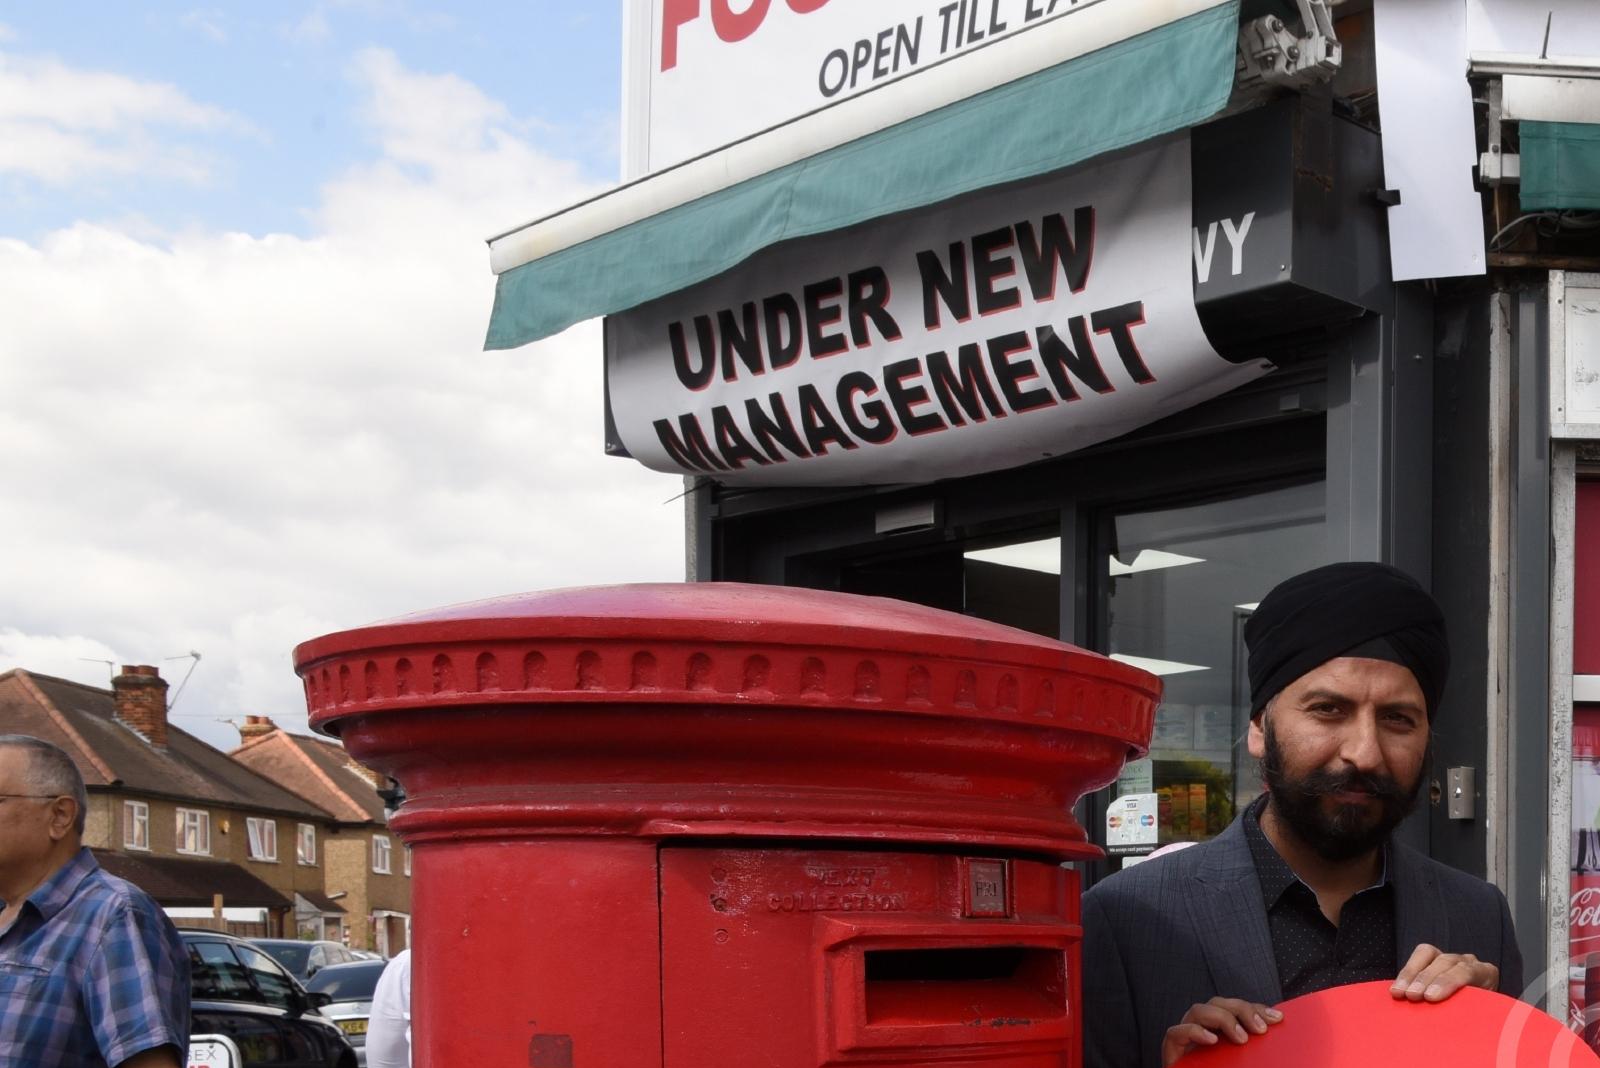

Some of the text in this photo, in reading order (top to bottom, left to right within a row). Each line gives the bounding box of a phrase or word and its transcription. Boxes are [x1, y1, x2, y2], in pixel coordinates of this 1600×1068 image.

[819, 15, 924, 98] OPEN
[668, 206, 1095, 391] UNDER NEW
[652, 301, 1156, 472] MANAGEMENT
[766, 890, 907, 913] COLLECTION
